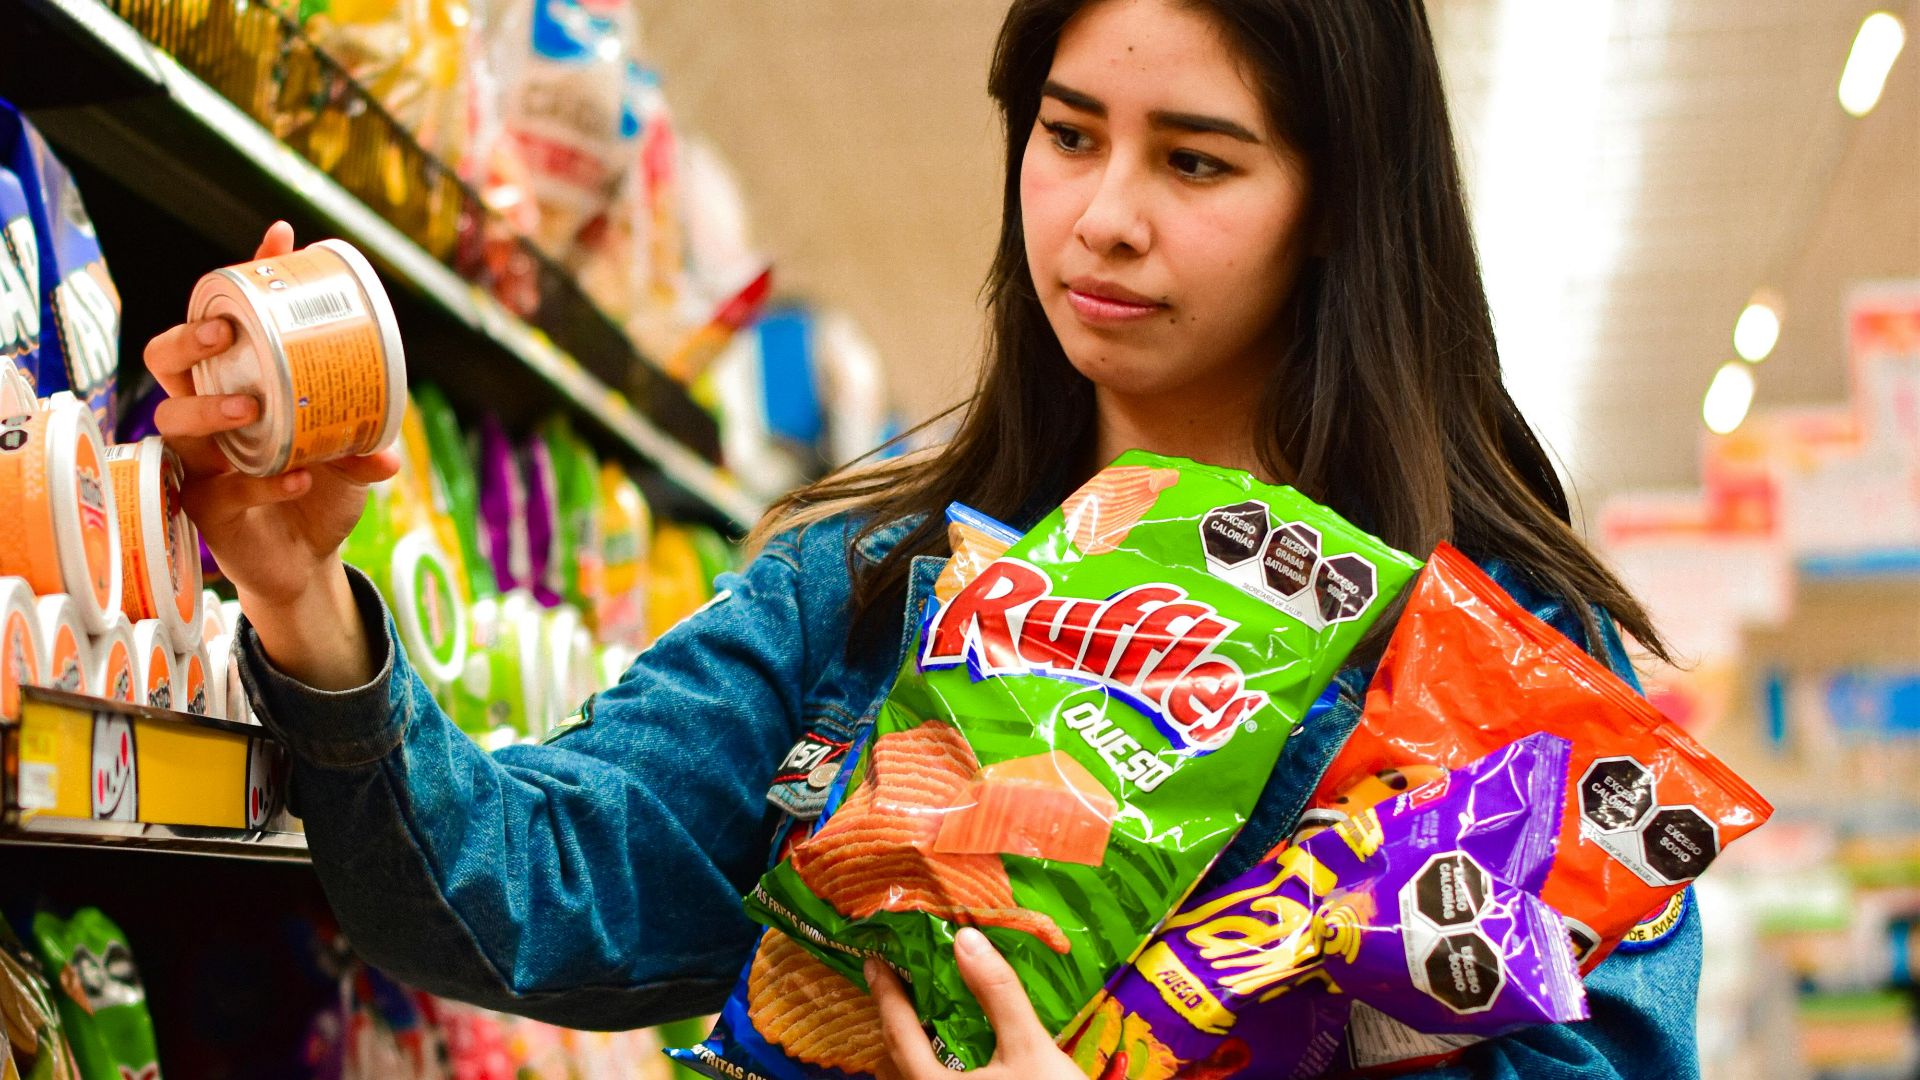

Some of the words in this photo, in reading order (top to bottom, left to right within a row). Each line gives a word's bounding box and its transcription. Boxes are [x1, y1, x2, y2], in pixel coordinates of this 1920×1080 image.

[1210, 520, 1255, 549] CALORÍAS
[1221, 511, 1256, 534] EXCESO
[1275, 547, 1305, 570] GRASAS
[1280, 535, 1309, 557] EXCESO
[1264, 557, 1307, 585] SATURADAS
[1326, 570, 1359, 595] EXCESO
[920, 556, 1271, 751] Ruffles
[1062, 702, 1174, 793] QUESO
[1604, 776, 1639, 804] EXCESO
[1659, 836, 1691, 863] SODIO
[1664, 823, 1702, 855] EXCESO
[1629, 930, 1646, 941] DE
[1652, 890, 1685, 938] AVIACIO
[1449, 954, 1466, 992] SODIO
[1156, 969, 1203, 1009] FUEGO
